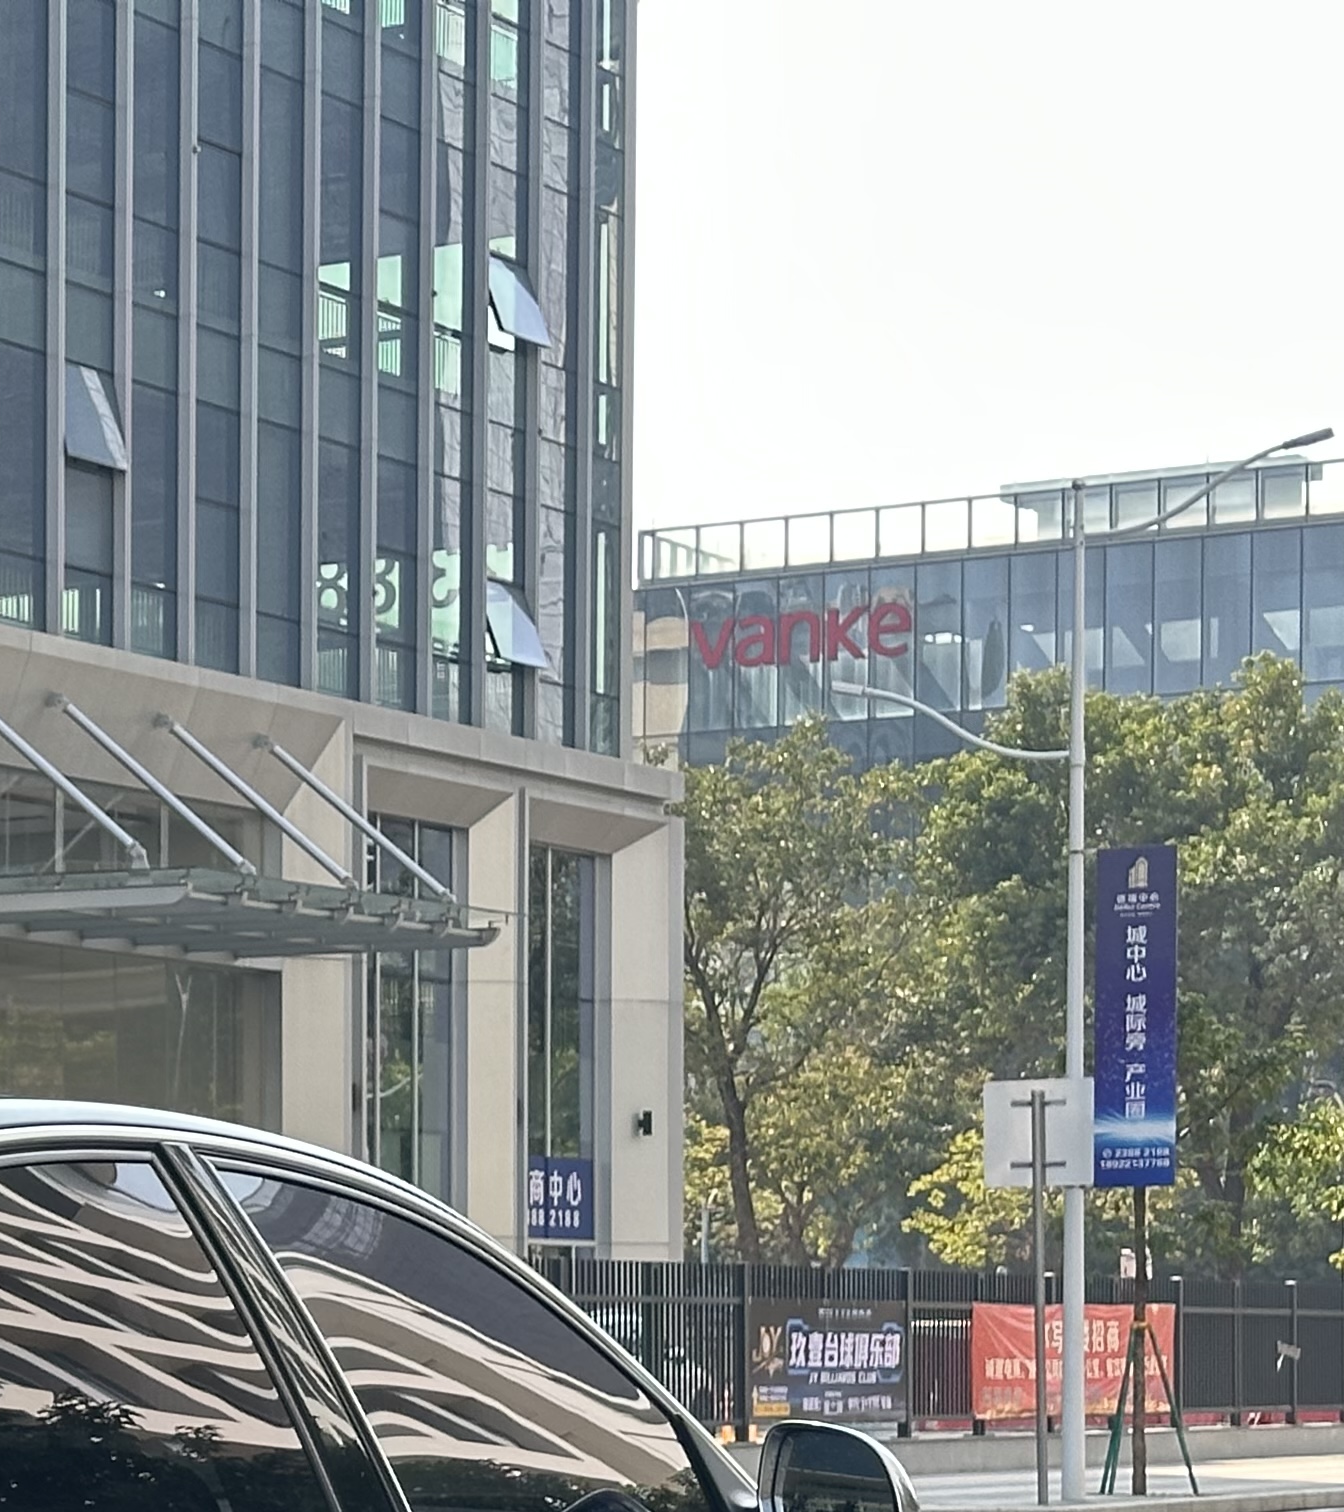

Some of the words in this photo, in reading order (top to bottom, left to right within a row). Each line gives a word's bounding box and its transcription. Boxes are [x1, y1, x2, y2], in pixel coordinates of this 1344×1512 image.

[690, 602, 912, 670] vanke
[1125, 925, 1148, 982] 城中心
[529, 1169, 582, 1207] 商中心
